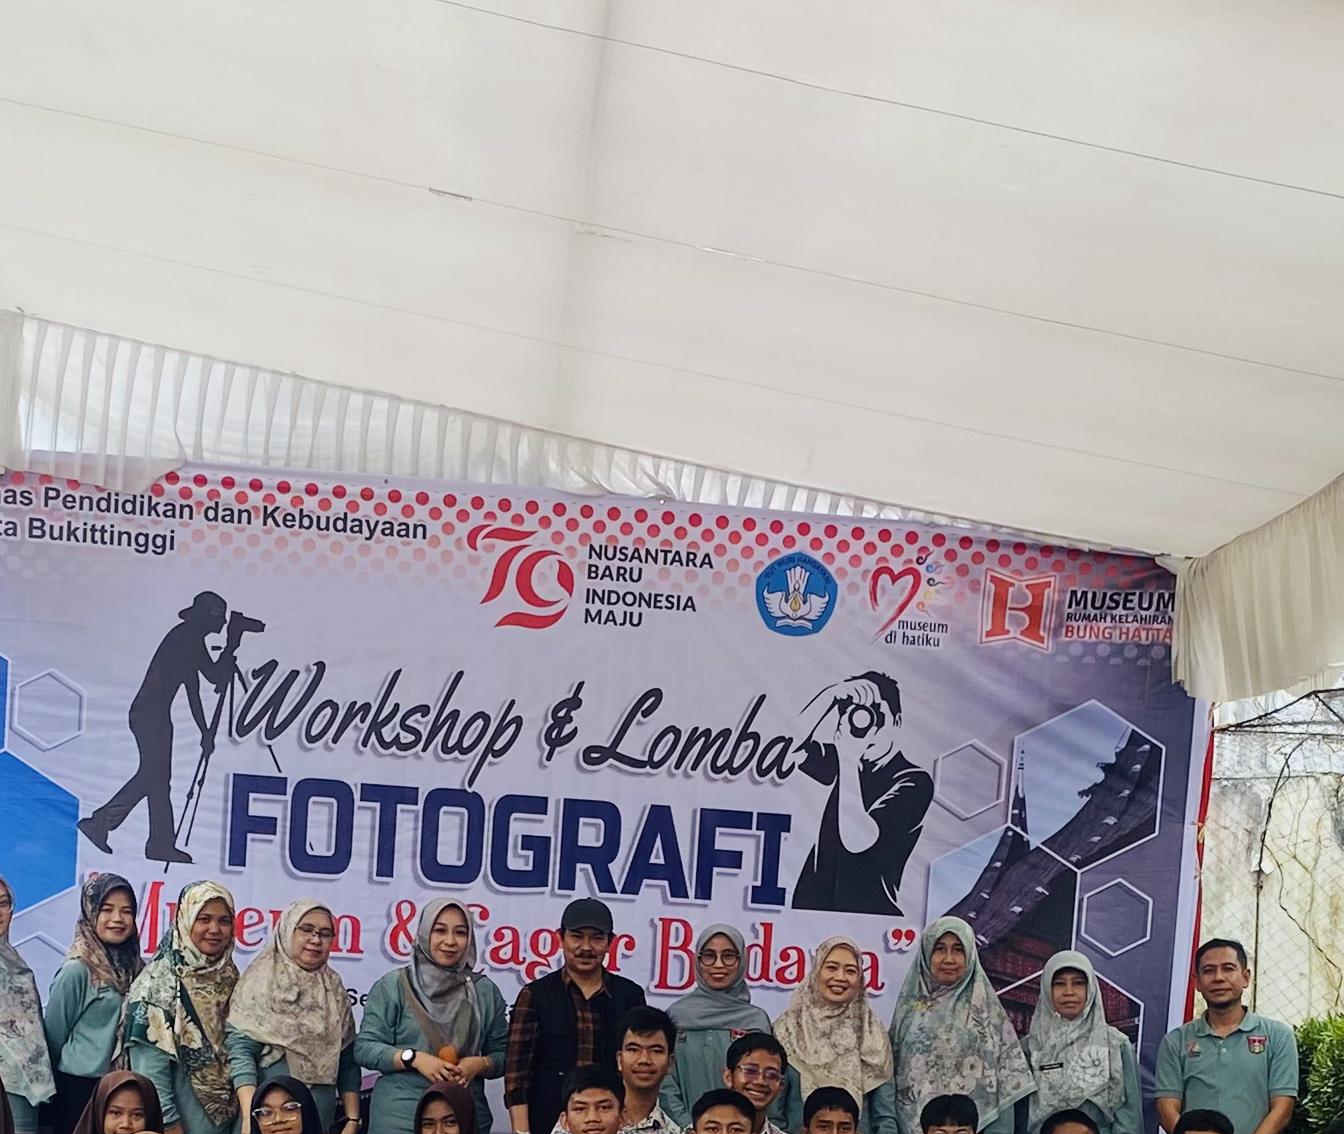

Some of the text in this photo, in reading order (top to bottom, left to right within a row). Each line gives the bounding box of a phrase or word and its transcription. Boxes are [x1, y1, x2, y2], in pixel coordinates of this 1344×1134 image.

[44, 486, 194, 521] Pendidikan
[203, 498, 253, 526] dan
[262, 505, 428, 540] Kebudayaan
[29, 518, 176, 555] Bukittinggi
[588, 544, 714, 569] NUSANTARA
[587, 564, 642, 583] BARU
[585, 588, 697, 612] INDONESIA
[1067, 590, 1176, 612] MUSEUM
[584, 608, 643, 628] MAJU
[898, 620, 948, 633] museum
[1066, 612, 1107, 624] RUMAH
[885, 630, 941, 647] di hatiku
[1064, 625, 1172, 641] BUNG HATTA
[235, 659, 797, 787] Workshop & Lomba
[228, 773, 792, 906] FOTOGRAFI
